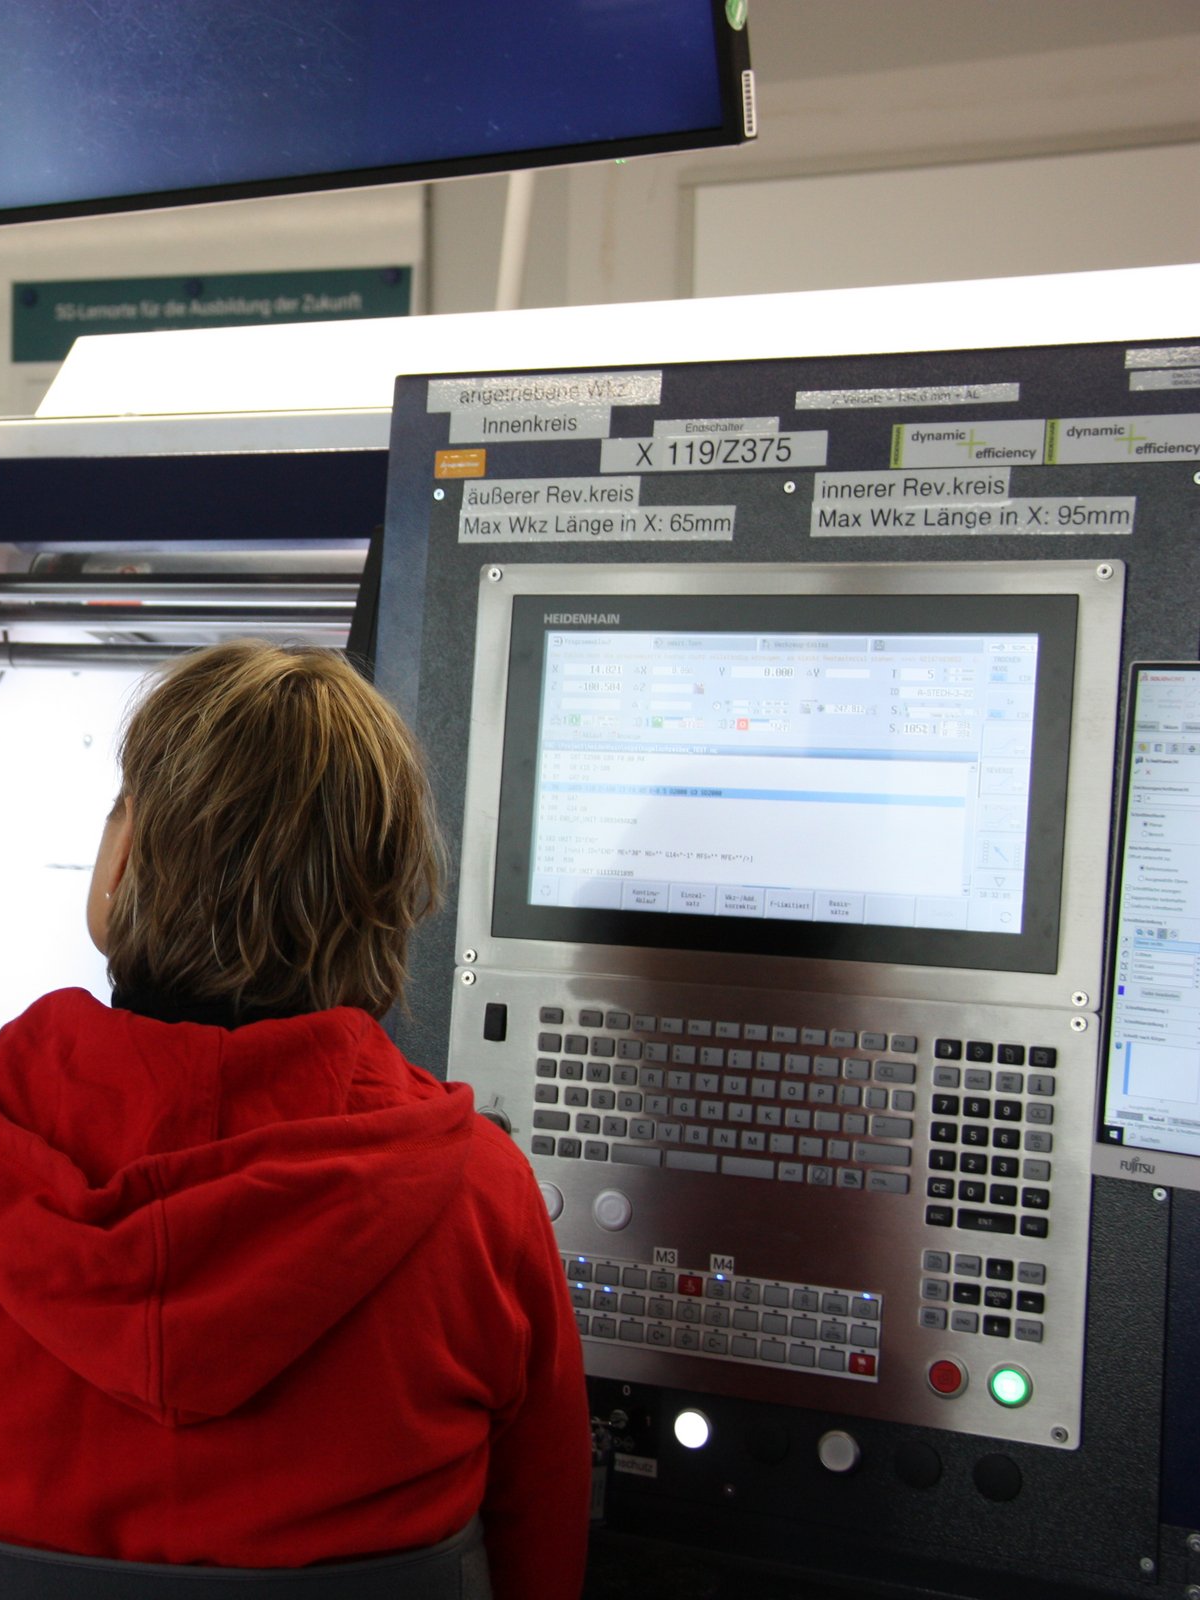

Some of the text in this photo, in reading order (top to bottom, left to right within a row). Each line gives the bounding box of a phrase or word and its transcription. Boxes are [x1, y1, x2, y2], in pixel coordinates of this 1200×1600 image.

[274, 296, 298, 313] der
[302, 293, 362, 313] Zukunft
[459, 383, 580, 406] angetriebene
[482, 414, 577, 435] Innenkreis
[685, 421, 744, 433] Endschalter
[1066, 424, 1125, 439] dynamic
[911, 429, 966, 445] dynamic
[636, 437, 791, 467] X 119/Z375
[975, 447, 1037, 460] efficiency
[1135, 440, 1200, 457] efficiency
[821, 477, 1005, 499] innerer Rev.kreis
[468, 484, 634, 505] äußerer Rev.kreis
[819, 506, 1130, 529] Max Wkz Länge in X: 95mm
[464, 512, 731, 537] Max Wkz Länge in X: 65mm
[543, 613, 620, 625] HEIDENHAIN
[591, 1068, 603, 1078] W
[621, 1070, 627, 1080] E
[648, 1073, 655, 1083] R
[675, 1075, 683, 1085] T
[703, 1078, 711, 1088] Y
[730, 1081, 739, 1091] U
[817, 1088, 824, 1098] P
[625, 1098, 633, 1107] D
[653, 1100, 659, 1110] F
[941, 1100, 948, 1110] 7
[680, 1103, 688, 1113] G
[707, 1106, 716, 1115] H
[737, 1108, 744, 1118] J
[971, 1103, 978, 1113] 8
[1003, 1106, 1010, 1116] 9
[765, 1111, 772, 1121] K
[794, 1113, 800, 1123] L
[583, 1119, 590, 1129] Z
[609, 1122, 617, 1132] X
[637, 1125, 645, 1135] C
[665, 1127, 673, 1137] V
[692, 1130, 700, 1140] B
[938, 1127, 946, 1137] 4
[720, 1133, 729, 1143] N
[748, 1136, 757, 1146] M
[970, 1131, 977, 1141] 5
[1001, 1134, 1009, 1144] 6
[938, 1156, 944, 1165] 1
[968, 1159, 976, 1169] 2
[1000, 1162, 1007, 1172] 3
[1120, 1158, 1155, 1175] FUJITSU
[932, 1183, 947, 1194] CE
[967, 1187, 974, 1197] 0
[977, 1217, 993, 1226] ENT
[656, 1250, 676, 1264] M3
[713, 1257, 733, 1272] M4
